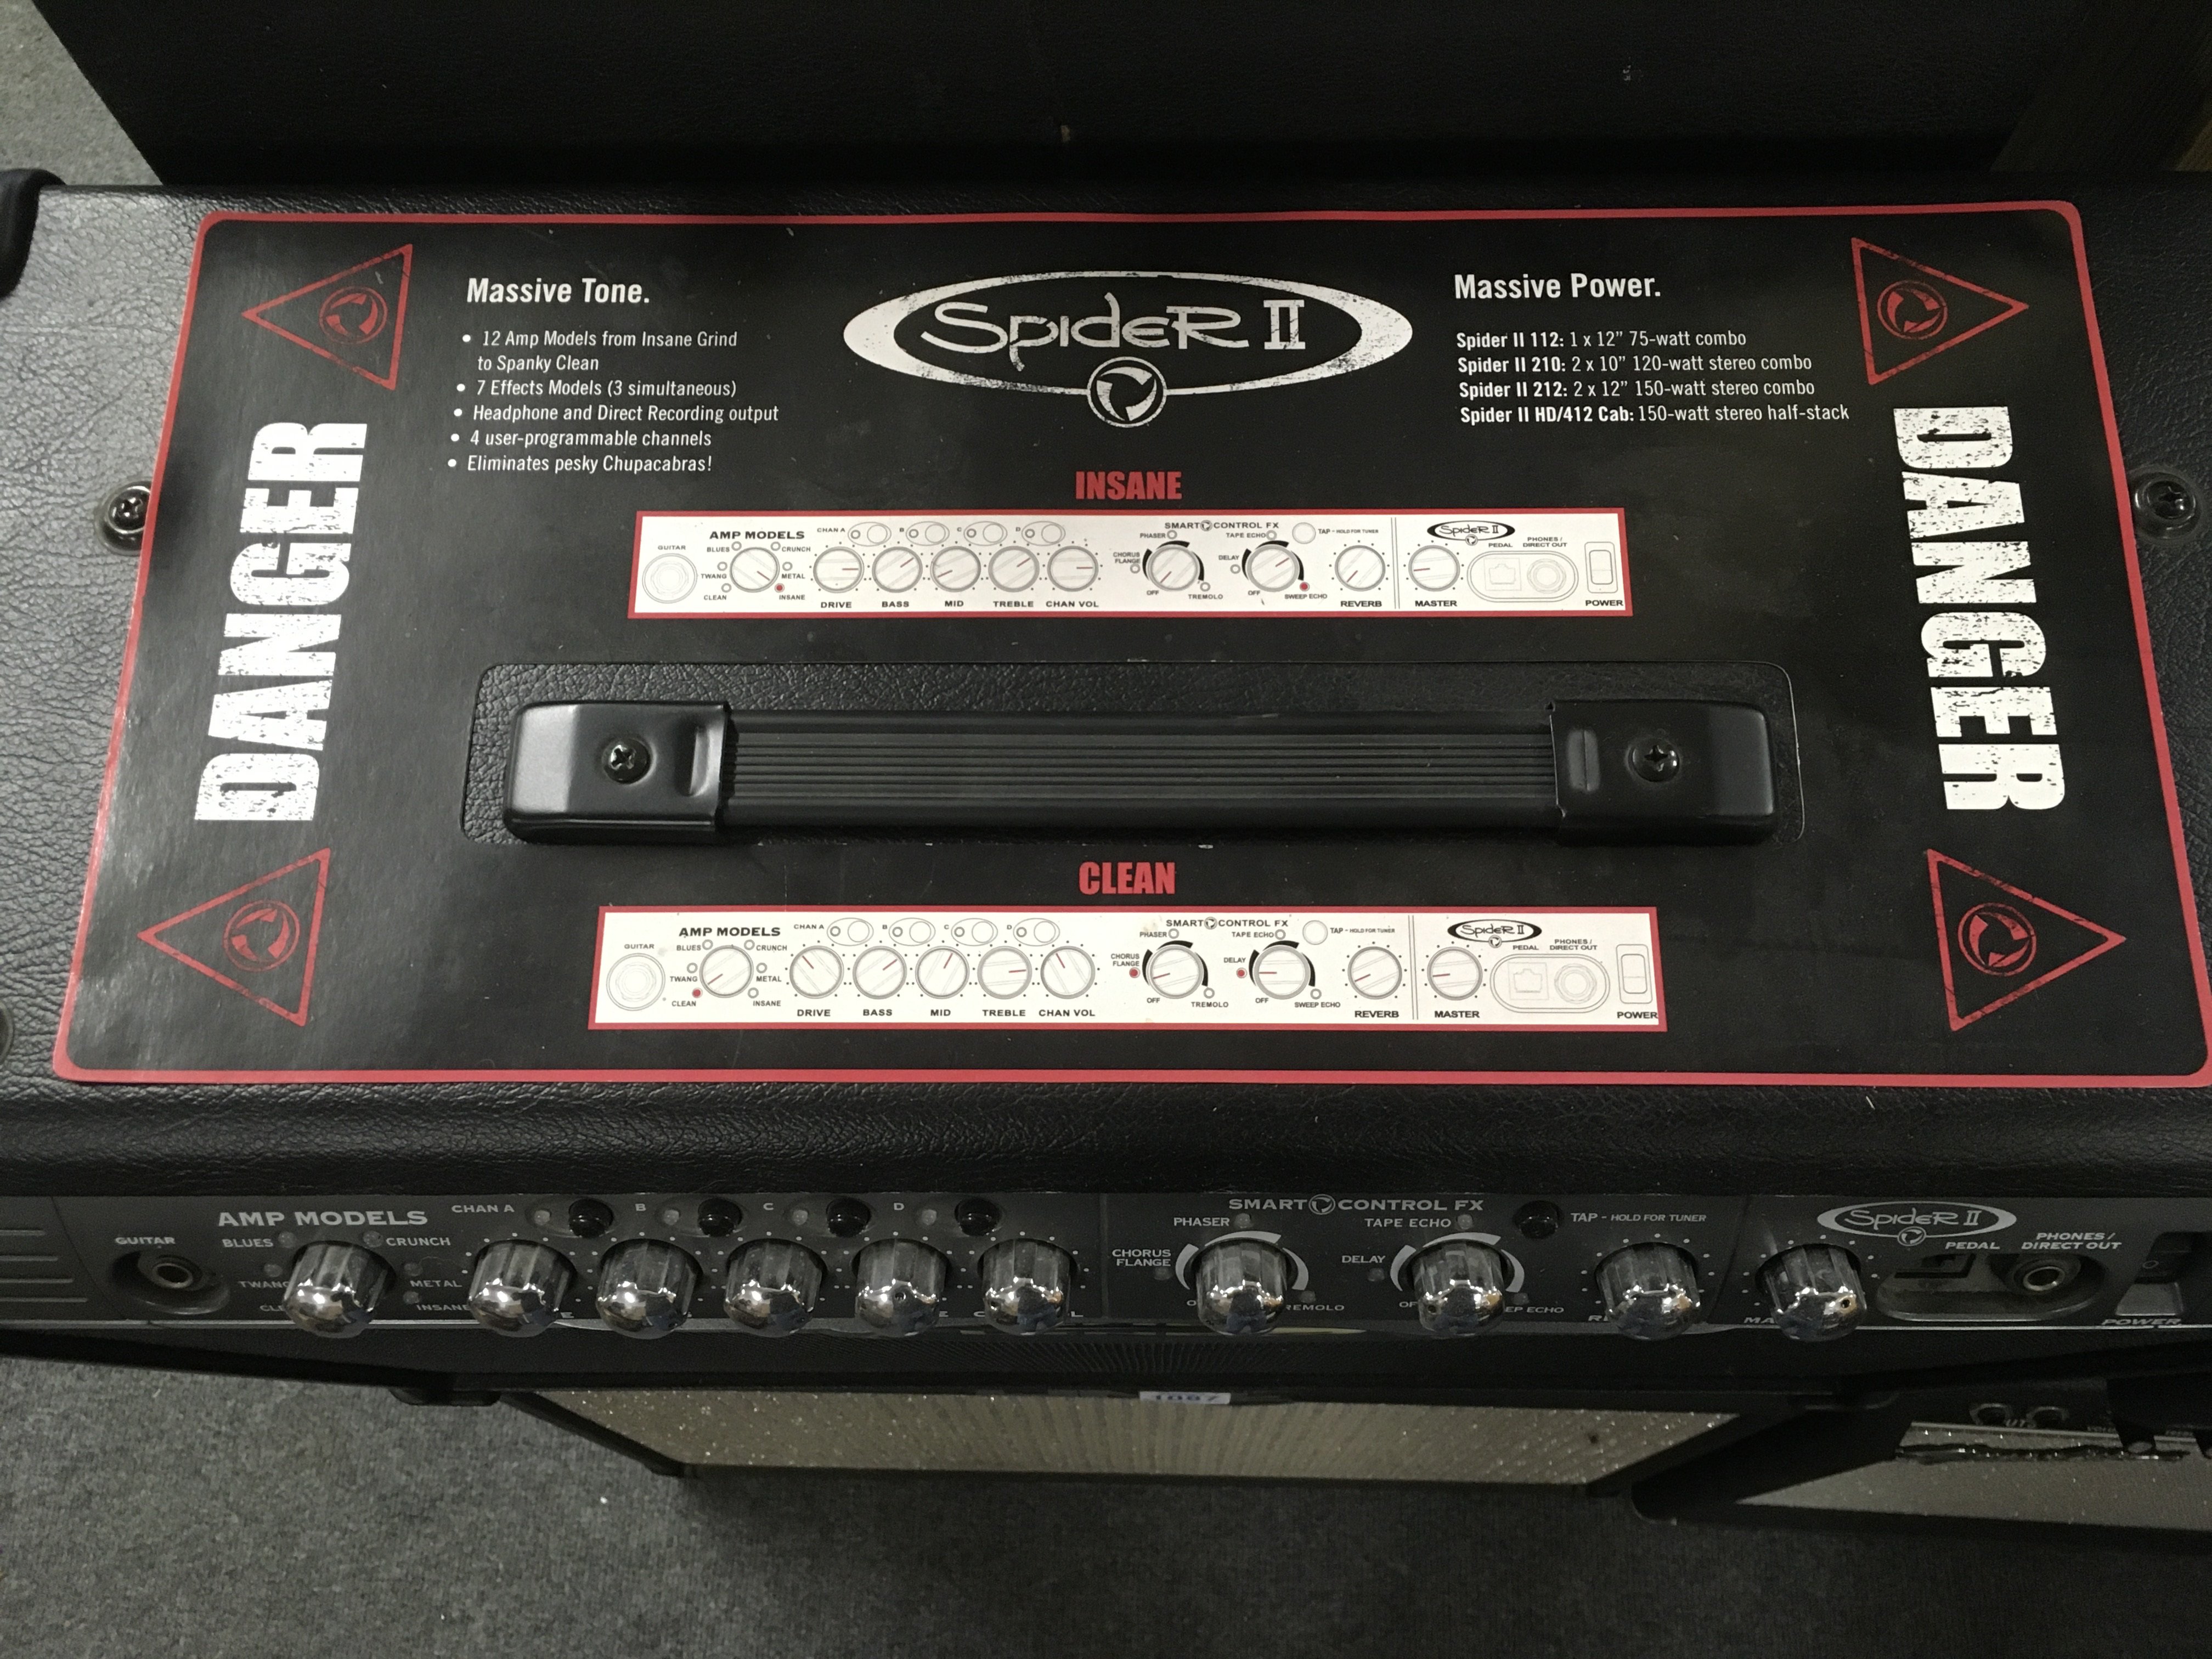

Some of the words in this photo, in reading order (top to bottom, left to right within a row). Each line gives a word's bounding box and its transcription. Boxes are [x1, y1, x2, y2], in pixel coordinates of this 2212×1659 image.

[467, 278, 571, 303] Massive
[582, 278, 649, 303] Tone.
[1455, 274, 1560, 298] Massive
[1571, 273, 1660, 297] Power.
[1263, 300, 1305, 349] II
[483, 331, 500, 346] 12
[505, 331, 538, 348] Amp
[544, 331, 596, 346] Models
[602, 331, 635, 346] from
[642, 331, 692, 346] Insane
[698, 331, 737, 346] Grind
[1457, 332, 1508, 351] Spider
[1514, 332, 1524, 347] II
[1531, 332, 1564, 347] 112:
[1571, 332, 1577, 346] 1
[1583, 336, 1591, 346] x
[1629, 331, 1690, 346] 75-watt
[1696, 330, 1746, 345] combo
[478, 356, 492, 370] to
[497, 356, 551, 373] Spanky
[556, 355, 599, 370] Clean
[1458, 357, 1509, 375] Spider
[1515, 357, 1525, 371] II
[1532, 357, 1565, 371] 210:
[1572, 357, 1581, 371] 2
[1586, 360, 1594, 371] x
[1633, 356, 1703, 371] 120-watt
[1709, 356, 1756, 370] stereo
[1761, 354, 1812, 369] combo
[477, 380, 486, 395] 7
[491, 380, 543, 395] Effects
[549, 380, 601, 395] Models
[608, 380, 622, 397] (3
[628, 380, 736, 397] simultaneous)
[1460, 382, 1510, 400] Spider
[1517, 382, 1527, 397] II
[1533, 381, 1567, 397] 212:
[1574, 381, 1583, 396] 2
[1588, 385, 1596, 396] x
[1635, 380, 1706, 396] 150-watt
[1712, 381, 1758, 395] stereo
[1764, 379, 1814, 394] combo
[473, 405, 558, 423] Headphone
[563, 405, 592, 420] and
[598, 405, 642, 420] Direct
[648, 405, 724, 424] Recording
[729, 406, 778, 424] output
[1461, 407, 1512, 426] Spider
[1519, 407, 1528, 422] II
[1536, 407, 1592, 422] HD/412
[1599, 406, 1633, 421] Cab:
[1639, 405, 1709, 421] 150-watt
[1716, 406, 1762, 420] stereo
[1768, 404, 1849, 420] half-stack
[471, 430, 479, 445] 4
[486, 430, 637, 448] user-programmable
[642, 430, 711, 445] channels
[468, 455, 549, 471] Eliminates
[555, 455, 598, 473] pesky
[603, 455, 711, 474] Chupacabras!
[1076, 471, 1182, 500] INSANE
[1893, 407, 2065, 809] DANGER
[194, 422, 367, 820] DANGER
[1079, 862, 1175, 895] CLEAN
[679, 928, 712, 936] AMP
[717, 927, 780, 936] MODELS
[1517, 925, 1524, 934] II
[1229, 1199, 1307, 1210] SMART
[1338, 1200, 1447, 1210] CONTROL
[1455, 1200, 1483, 1210] FX
[219, 1212, 284, 1226] AMP
[295, 1211, 427, 1225] MODELS
[1174, 1217, 1229, 1226] PHASER
[1364, 1218, 1403, 1227] TAPE
[1409, 1218, 1451, 1227] ECHO
[1571, 1213, 1598, 1222] TAP
[1963, 1210, 1982, 1226] II
[222, 1239, 273, 1247] BLUES
[386, 1238, 450, 1246] CRUNCH
